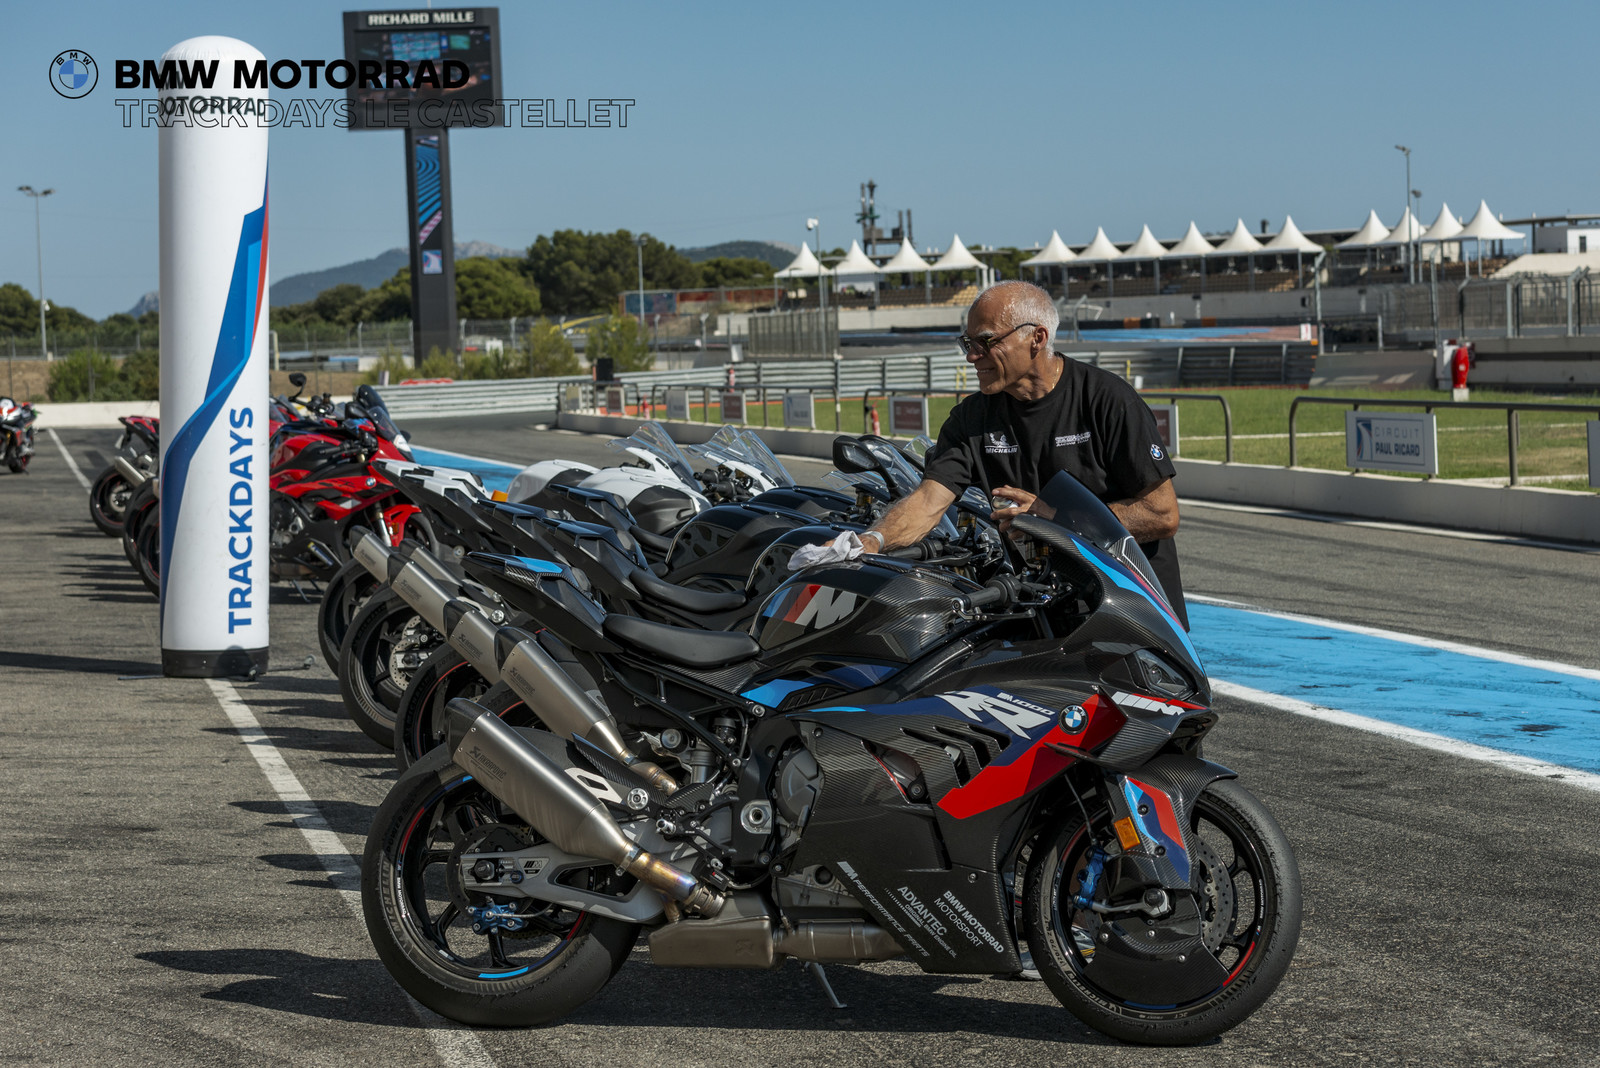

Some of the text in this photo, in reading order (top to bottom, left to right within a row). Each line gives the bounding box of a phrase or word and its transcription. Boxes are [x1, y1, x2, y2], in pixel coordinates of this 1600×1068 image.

[367, 11, 475, 26] RICHARD MILLE
[1374, 426, 1420, 439] CIRCUIT
[1375, 442, 1421, 457] PAUL RICARD
[228, 407, 254, 635] TRACKDAYS
[1011, 698, 1056, 716] 1000
[382, 861, 401, 933] MICHELIN
[853, 879, 907, 933] PERFORMANCE
[903, 933, 931, 957] PARTS
[897, 886, 948, 937] ADVANTEC
[933, 897, 984, 948] MOTORSPORT
[943, 890, 1005, 953] BMW MOTORRAD
[1067, 972, 1108, 1007] MICHELIN
